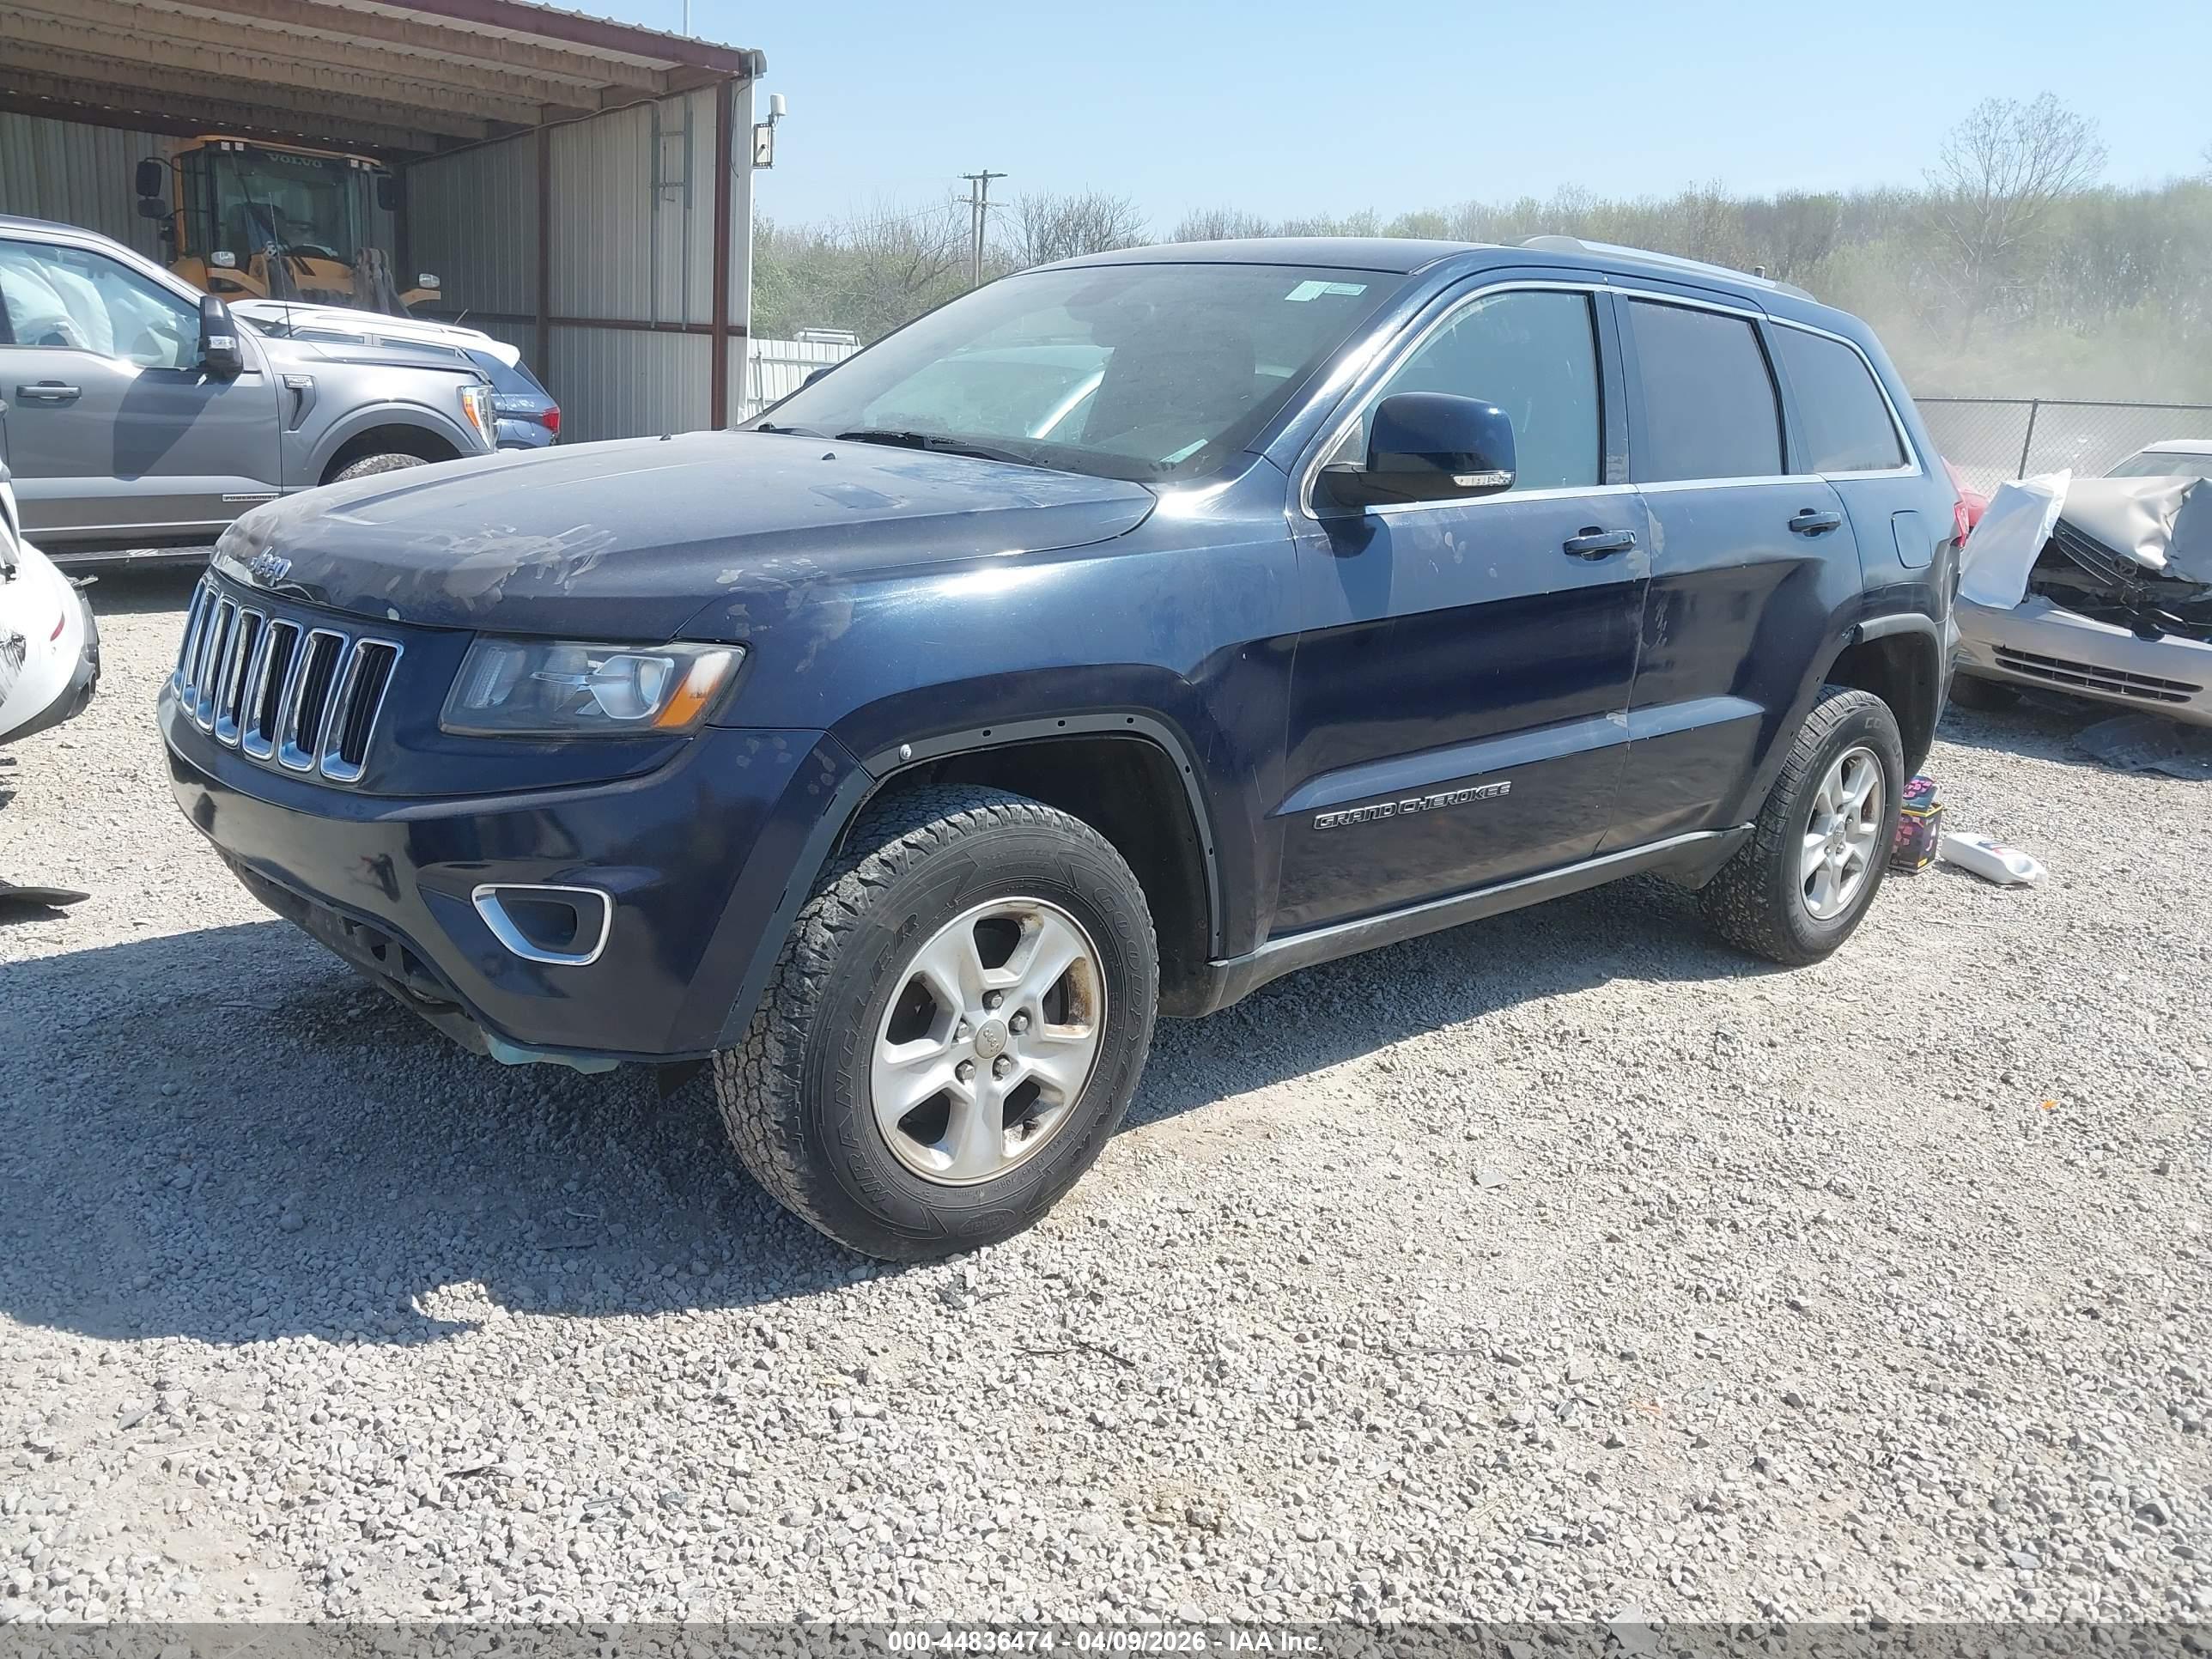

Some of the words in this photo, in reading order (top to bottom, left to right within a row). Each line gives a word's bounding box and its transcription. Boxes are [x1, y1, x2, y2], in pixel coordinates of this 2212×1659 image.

[265, 152, 323, 168] VOLVO
[1313, 802, 1396, 830] GRAND
[1398, 781, 1512, 814] CHEROKEE
